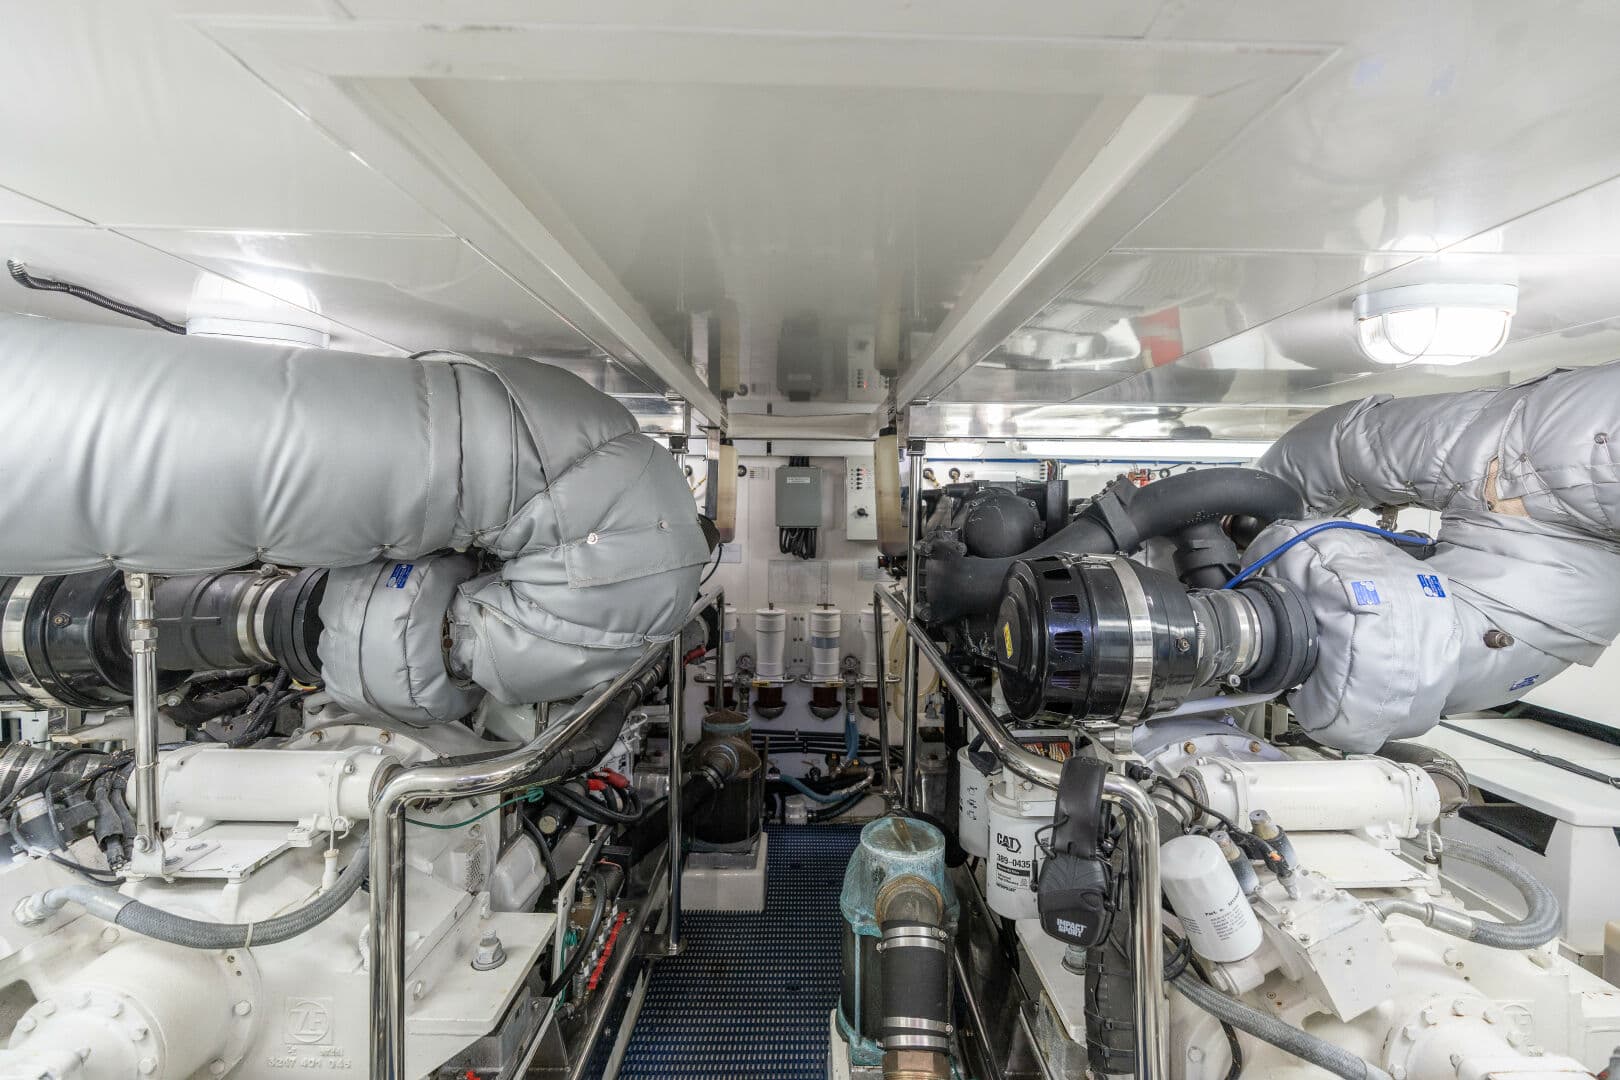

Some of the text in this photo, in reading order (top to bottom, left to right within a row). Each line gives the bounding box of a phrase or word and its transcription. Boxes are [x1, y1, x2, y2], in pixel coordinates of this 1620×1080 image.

[996, 832, 1018, 850] CAT
[996, 853, 1031, 868] 389-0435
[1056, 918, 1087, 932] IMPACT
